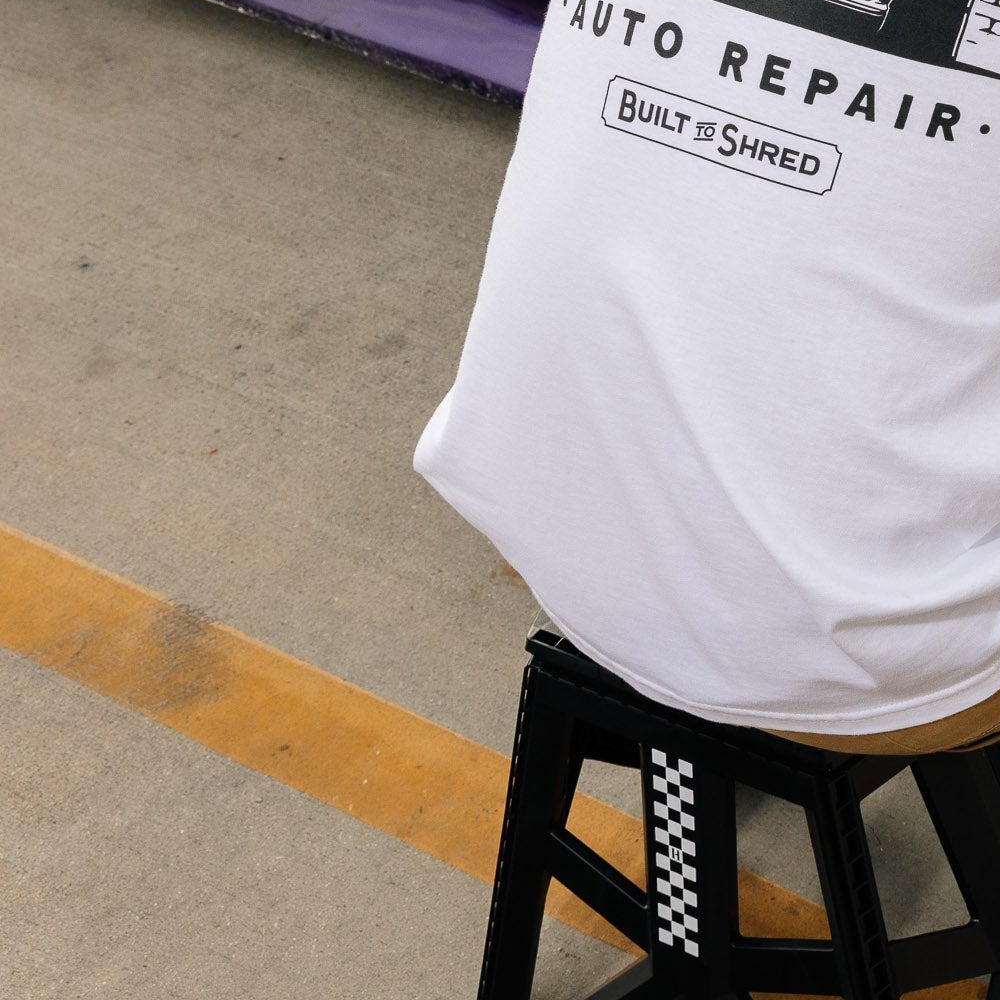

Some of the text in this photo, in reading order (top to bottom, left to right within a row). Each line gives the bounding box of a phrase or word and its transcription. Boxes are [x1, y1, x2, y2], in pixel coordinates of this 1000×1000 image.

[617, 88, 821, 176] BUILT TO SHRED
[718, 40, 961, 142] REPAIR
[671, 847, 681, 861] H
